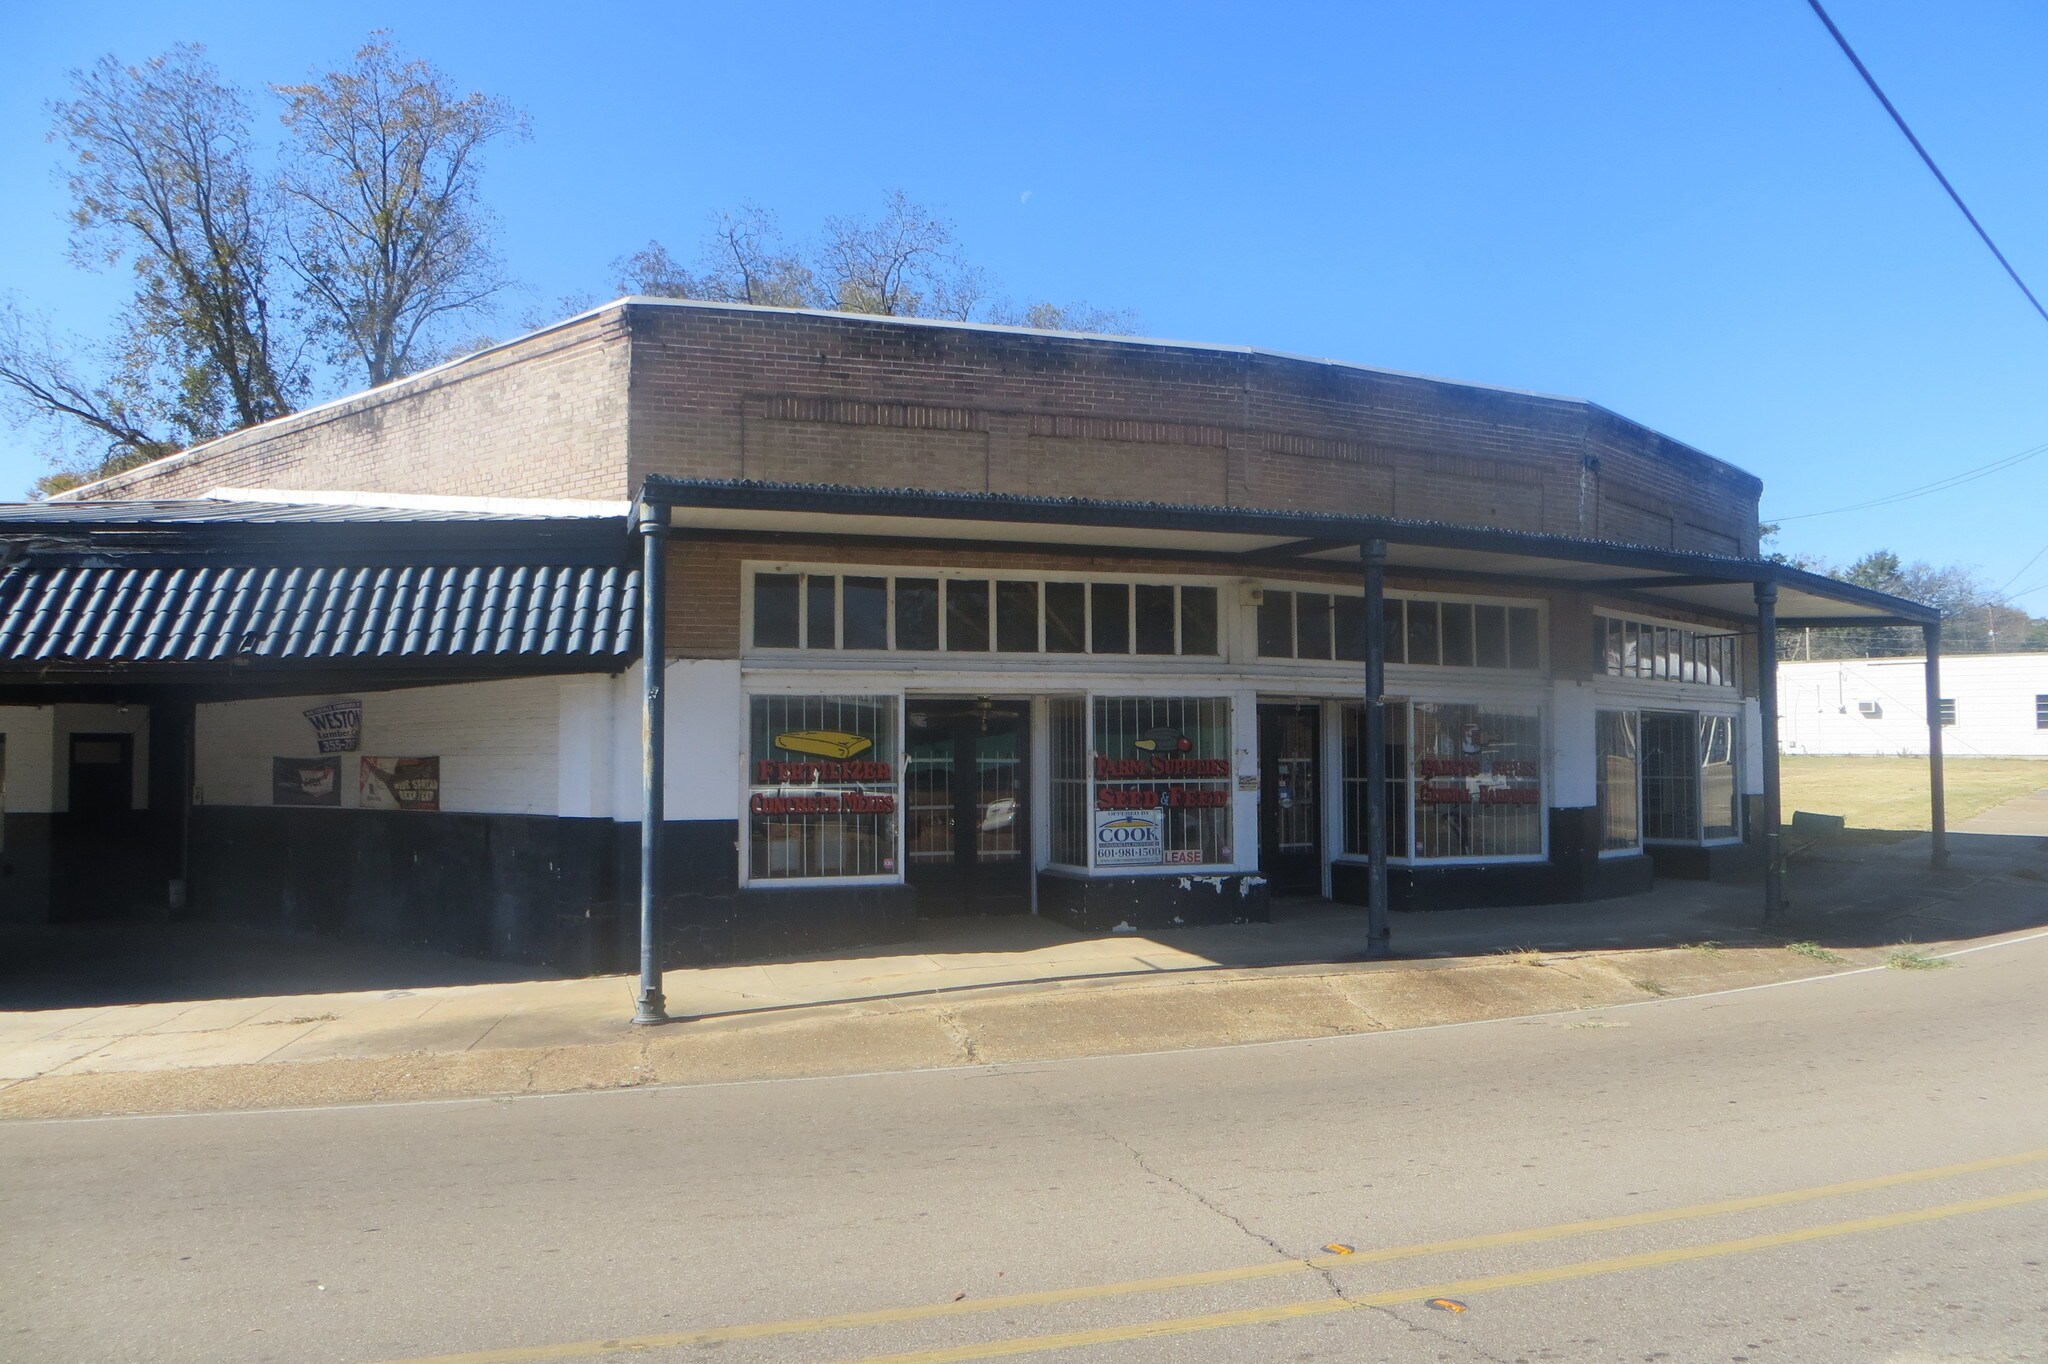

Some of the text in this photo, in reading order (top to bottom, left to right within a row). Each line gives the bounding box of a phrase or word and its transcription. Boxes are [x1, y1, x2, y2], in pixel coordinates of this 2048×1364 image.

[758, 761, 892, 783] FERTILIZER
[1095, 755, 1229, 779] FARM SUPPLIES
[752, 791, 895, 816] CONCRETE MIXES
[1098, 786, 1228, 809] SEED & FEED
[1098, 828, 1159, 843] COOK
[1165, 852, 1201, 864] LEASE
